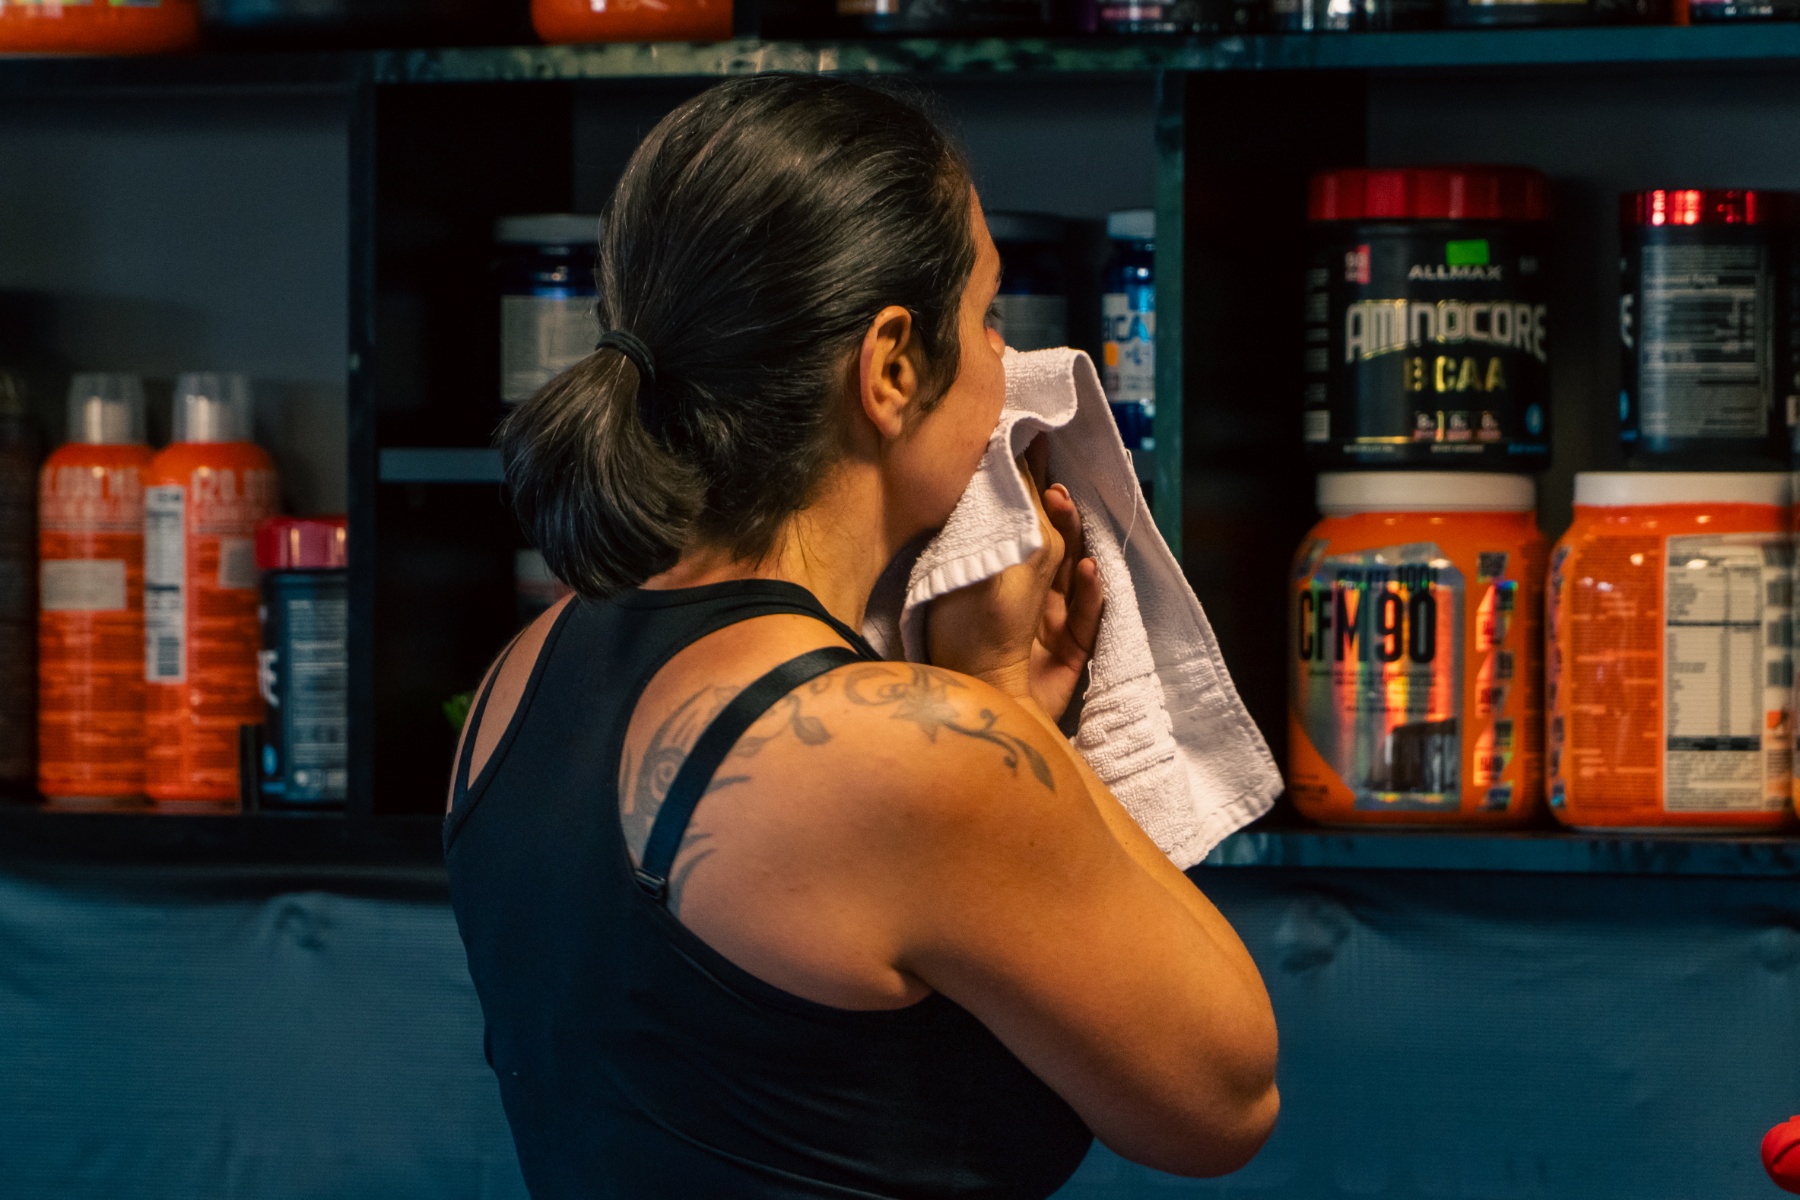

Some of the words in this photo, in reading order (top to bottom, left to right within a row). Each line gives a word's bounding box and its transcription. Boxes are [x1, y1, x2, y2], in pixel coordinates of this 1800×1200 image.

[1408, 264, 1502, 281] ALLMAX
[1345, 299, 1547, 364] AMINOCORE
[1403, 356, 1505, 392] BCAA
[1299, 588, 1369, 662] CFM
[1377, 590, 1437, 664] 90
